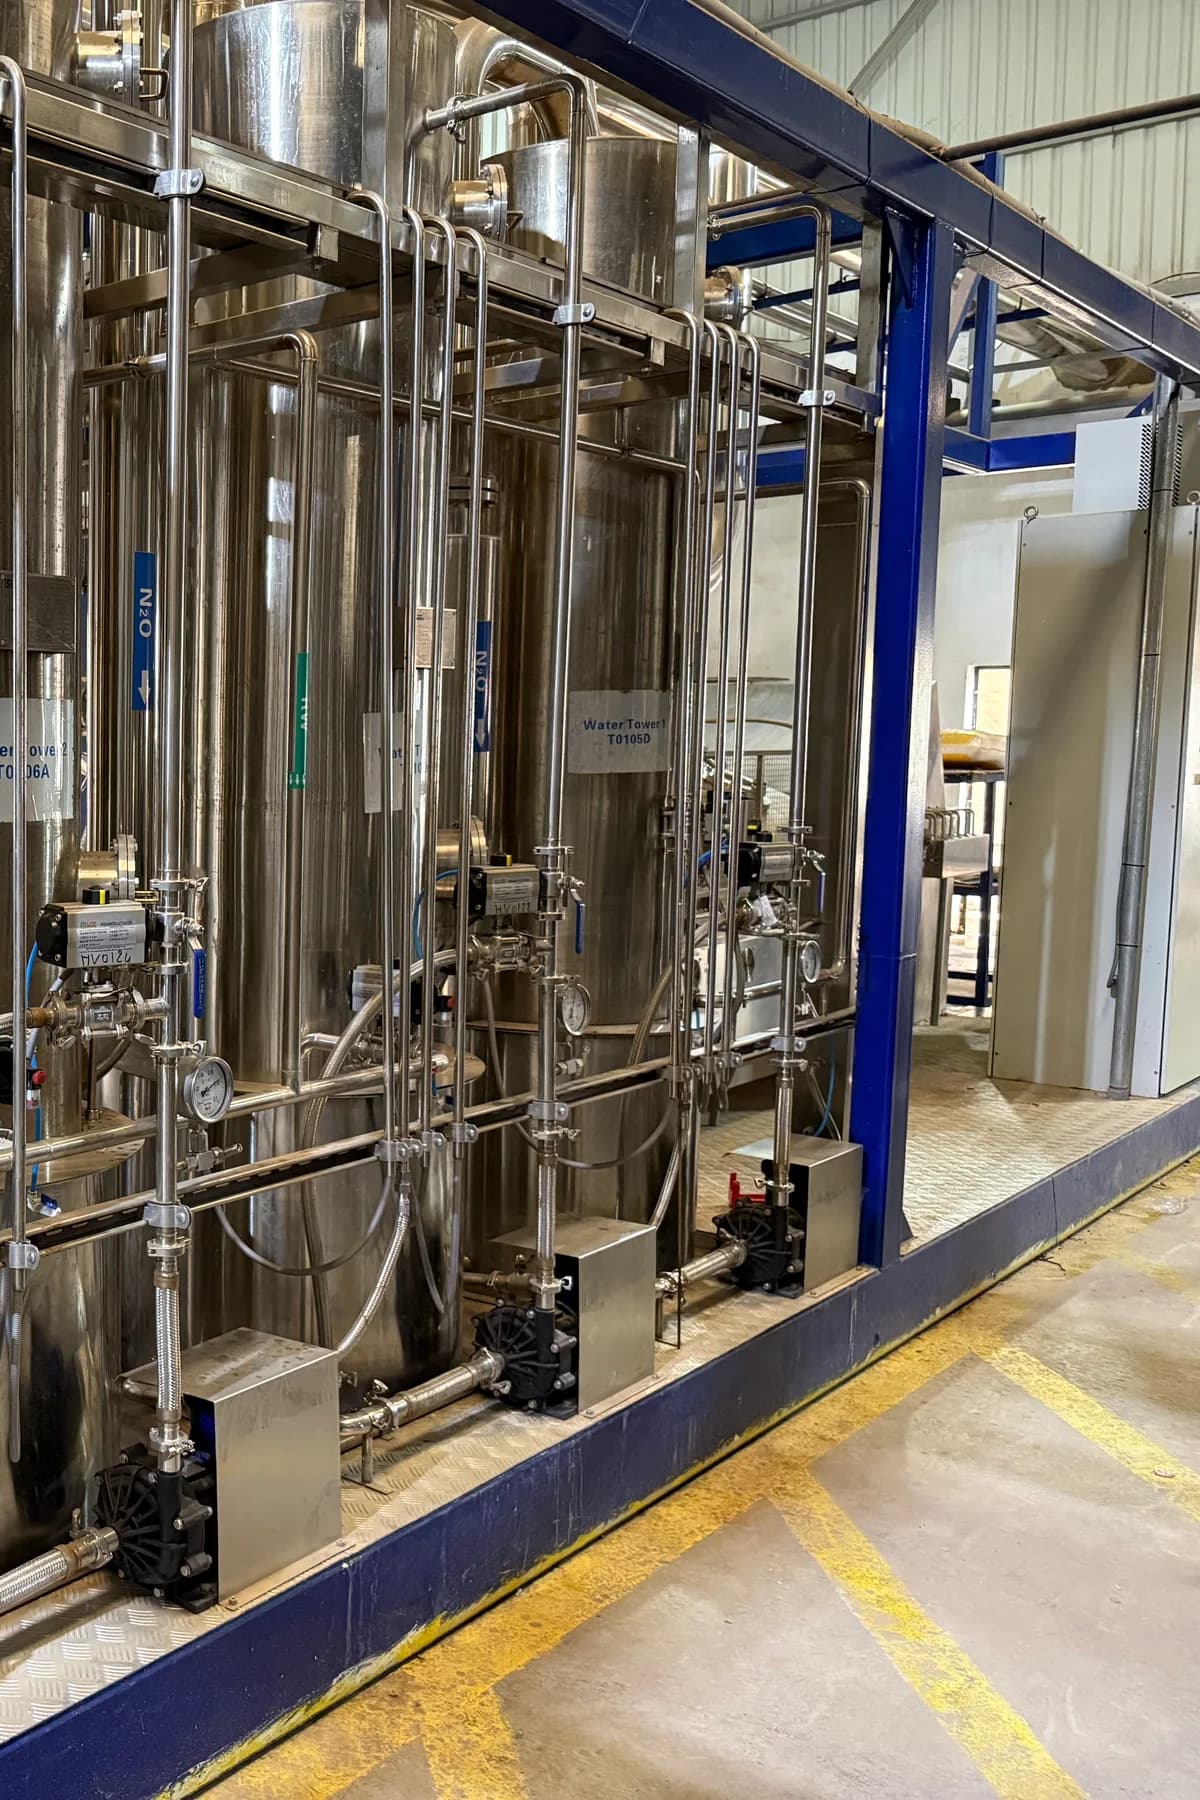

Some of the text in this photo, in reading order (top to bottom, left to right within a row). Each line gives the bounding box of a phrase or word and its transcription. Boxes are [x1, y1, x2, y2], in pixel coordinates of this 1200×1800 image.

[583, 719, 624, 730] Water
[626, 718, 660, 729] Tower
[607, 733, 651, 745] T0105D
